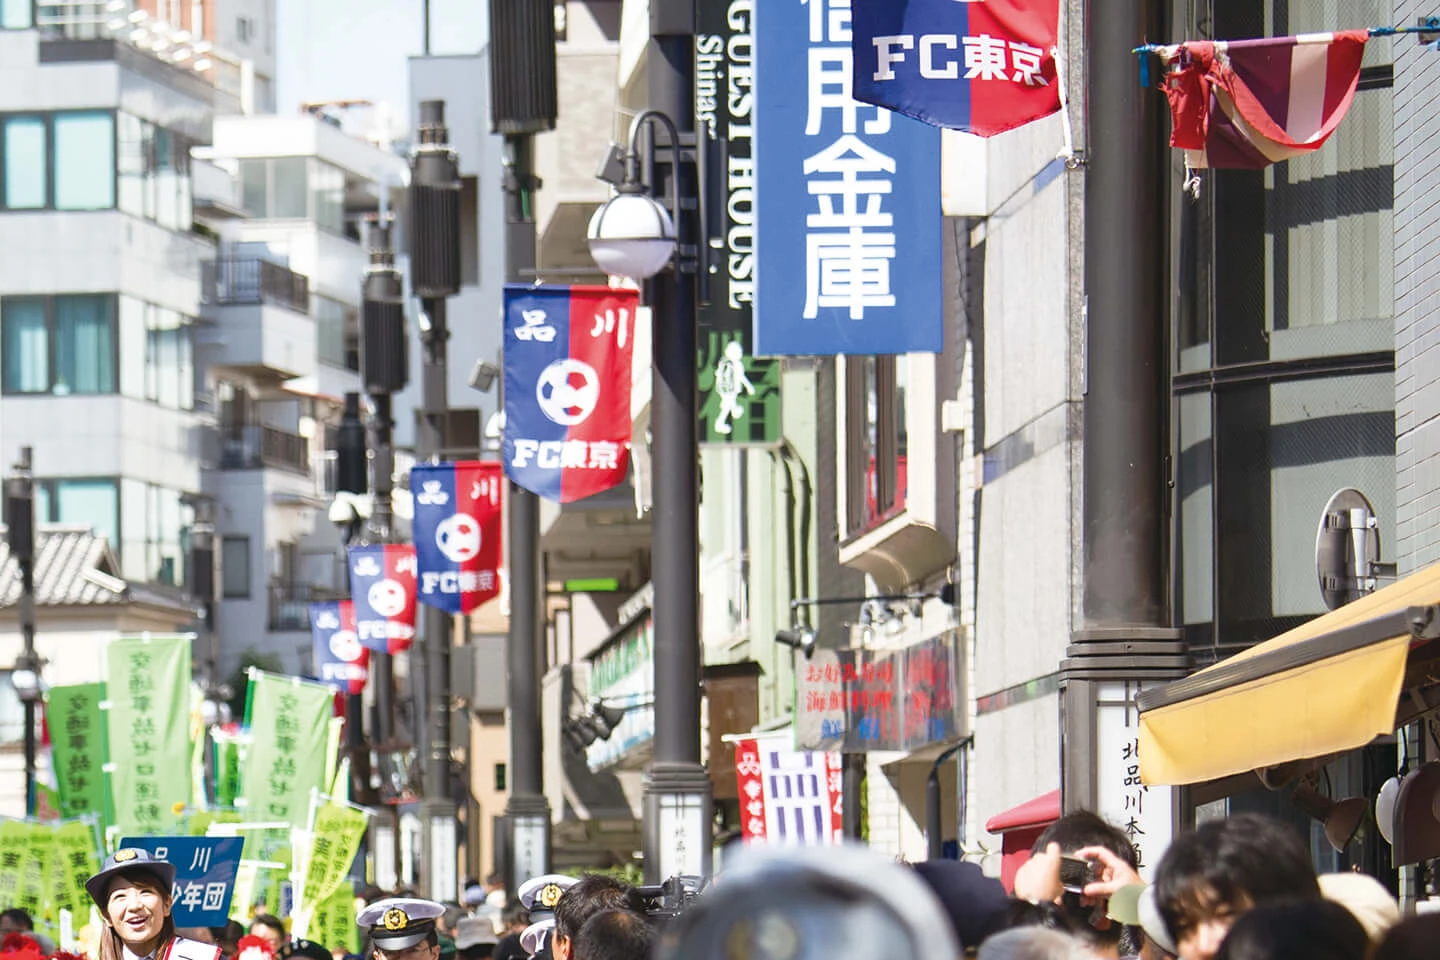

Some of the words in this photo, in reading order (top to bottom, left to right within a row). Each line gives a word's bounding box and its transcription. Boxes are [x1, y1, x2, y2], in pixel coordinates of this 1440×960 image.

[872, 34, 1049, 86] FC東京
[514, 308, 629, 348] 品川
[512, 438, 620, 470] FC東京
